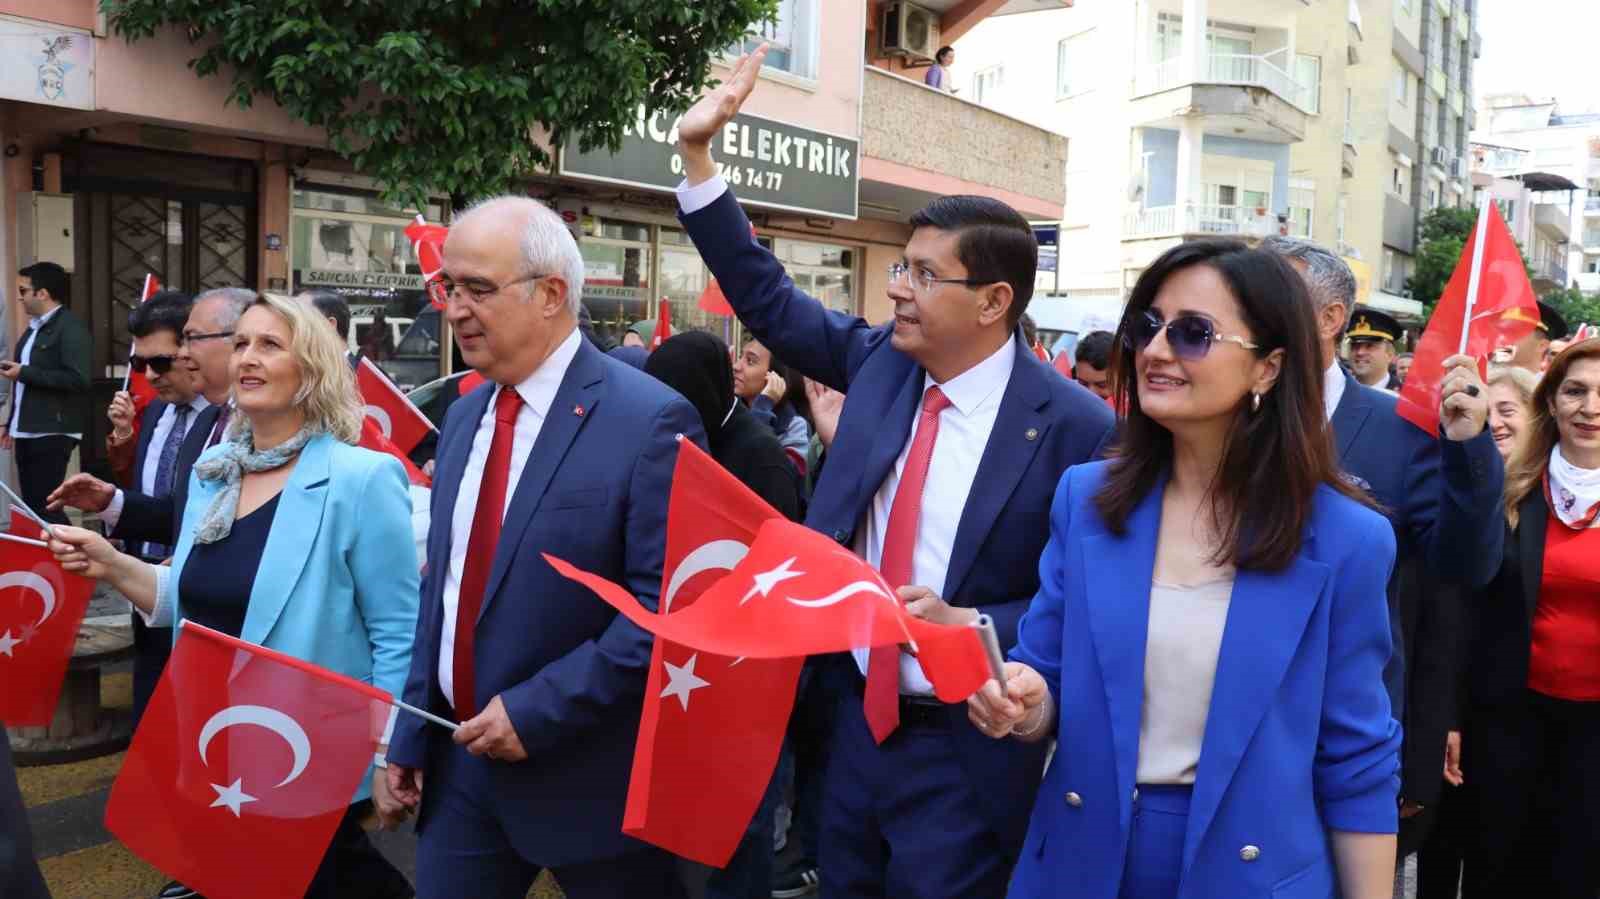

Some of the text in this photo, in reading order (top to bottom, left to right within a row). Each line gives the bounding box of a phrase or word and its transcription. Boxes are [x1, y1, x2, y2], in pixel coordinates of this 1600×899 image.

[722, 121, 850, 178] ELEKTRİK
[746, 167, 763, 189] 74
[766, 171, 783, 191] 77
